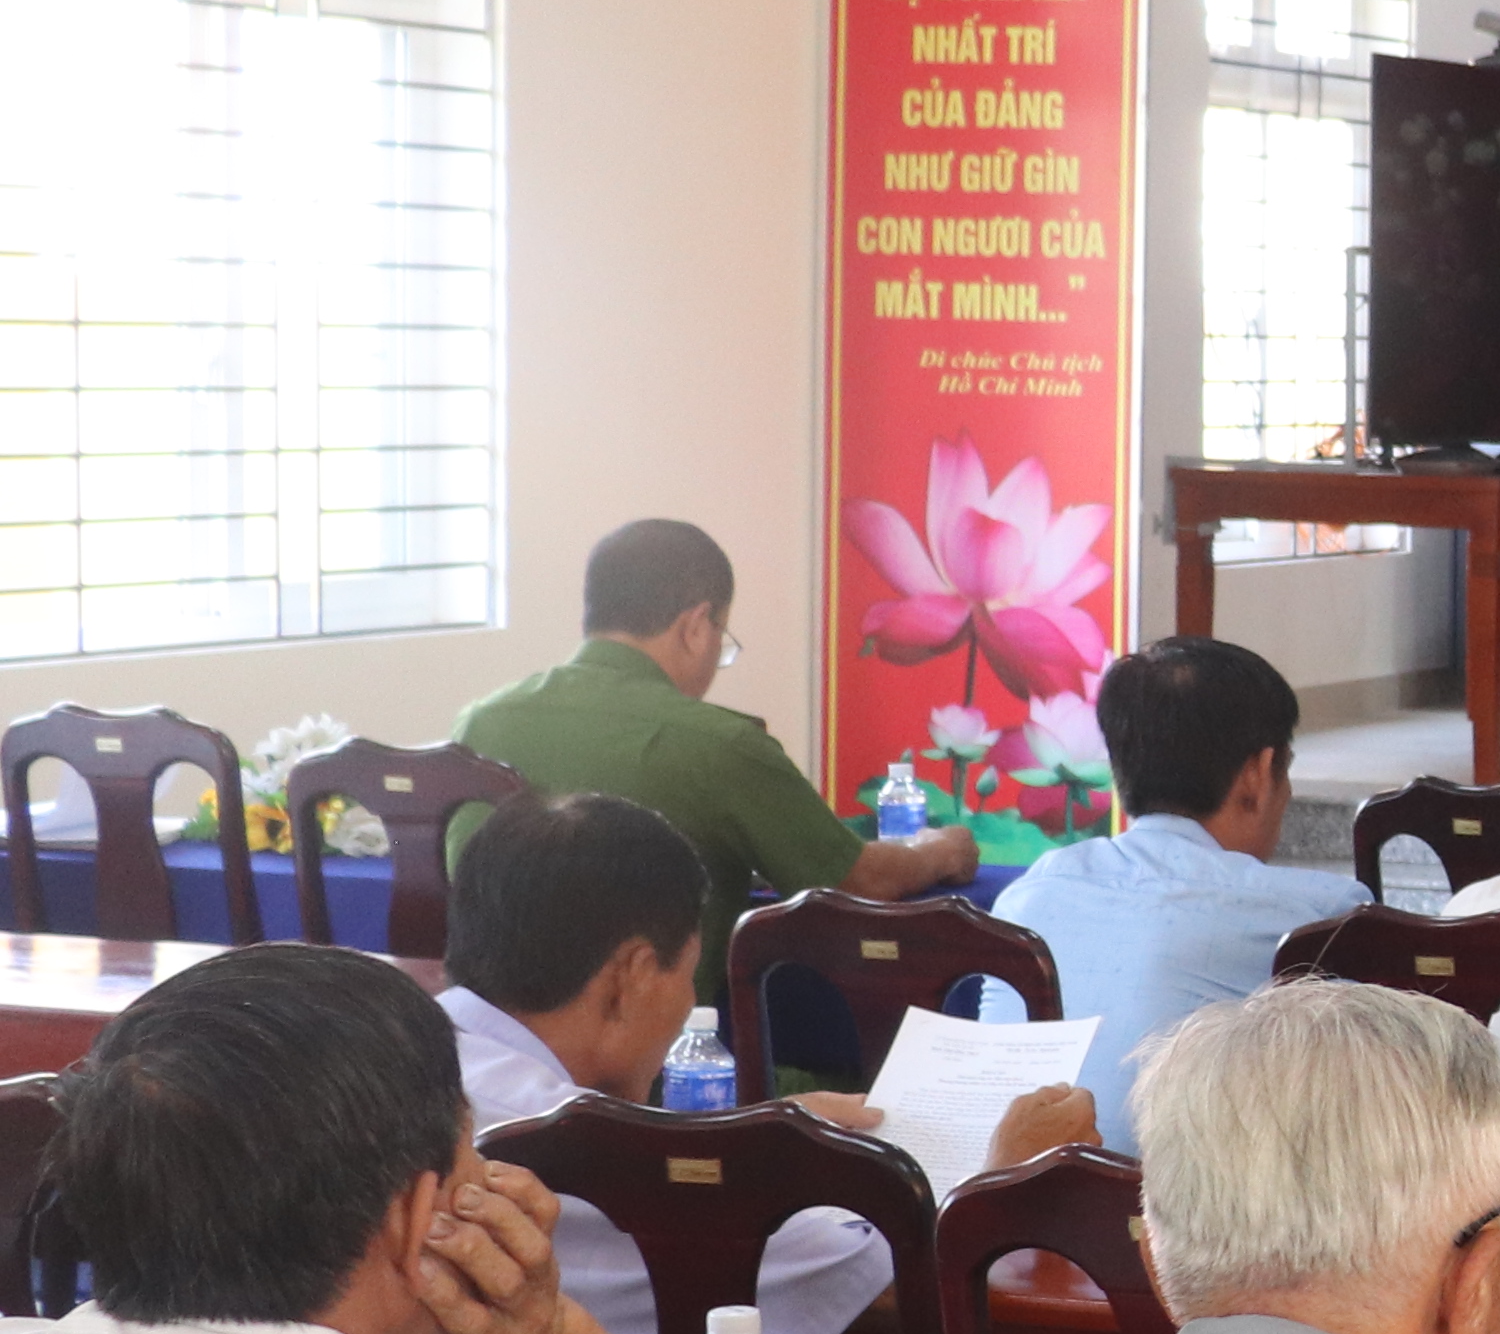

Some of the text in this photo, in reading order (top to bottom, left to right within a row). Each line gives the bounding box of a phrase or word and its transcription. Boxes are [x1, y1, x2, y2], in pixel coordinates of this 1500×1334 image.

[912, 14, 1057, 64] NHẤT TRÍ
[902, 78, 1067, 130] CỦA ĐẢNG
[885, 147, 1082, 195] NHƯ GIỮ GÌN
[875, 268, 944, 319] MẮT
